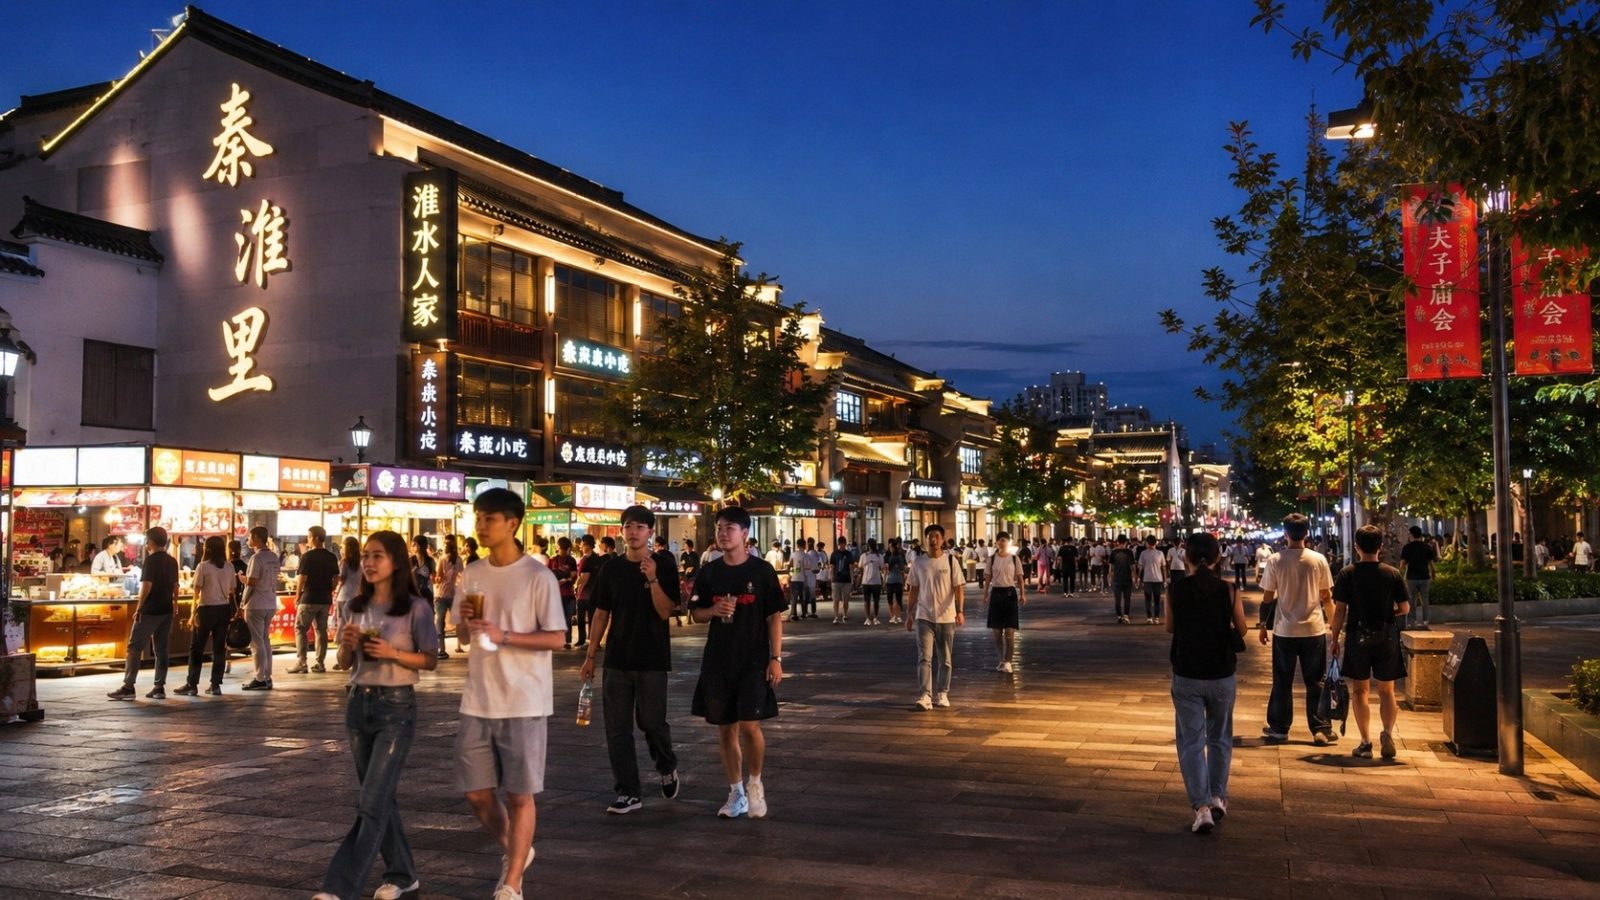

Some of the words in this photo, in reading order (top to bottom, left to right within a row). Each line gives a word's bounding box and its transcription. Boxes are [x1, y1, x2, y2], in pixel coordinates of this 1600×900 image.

[202, 82, 289, 402] 秦淮里
[412, 183, 440, 328] 淮水人家
[1429, 226, 1456, 331] 夫子庙会
